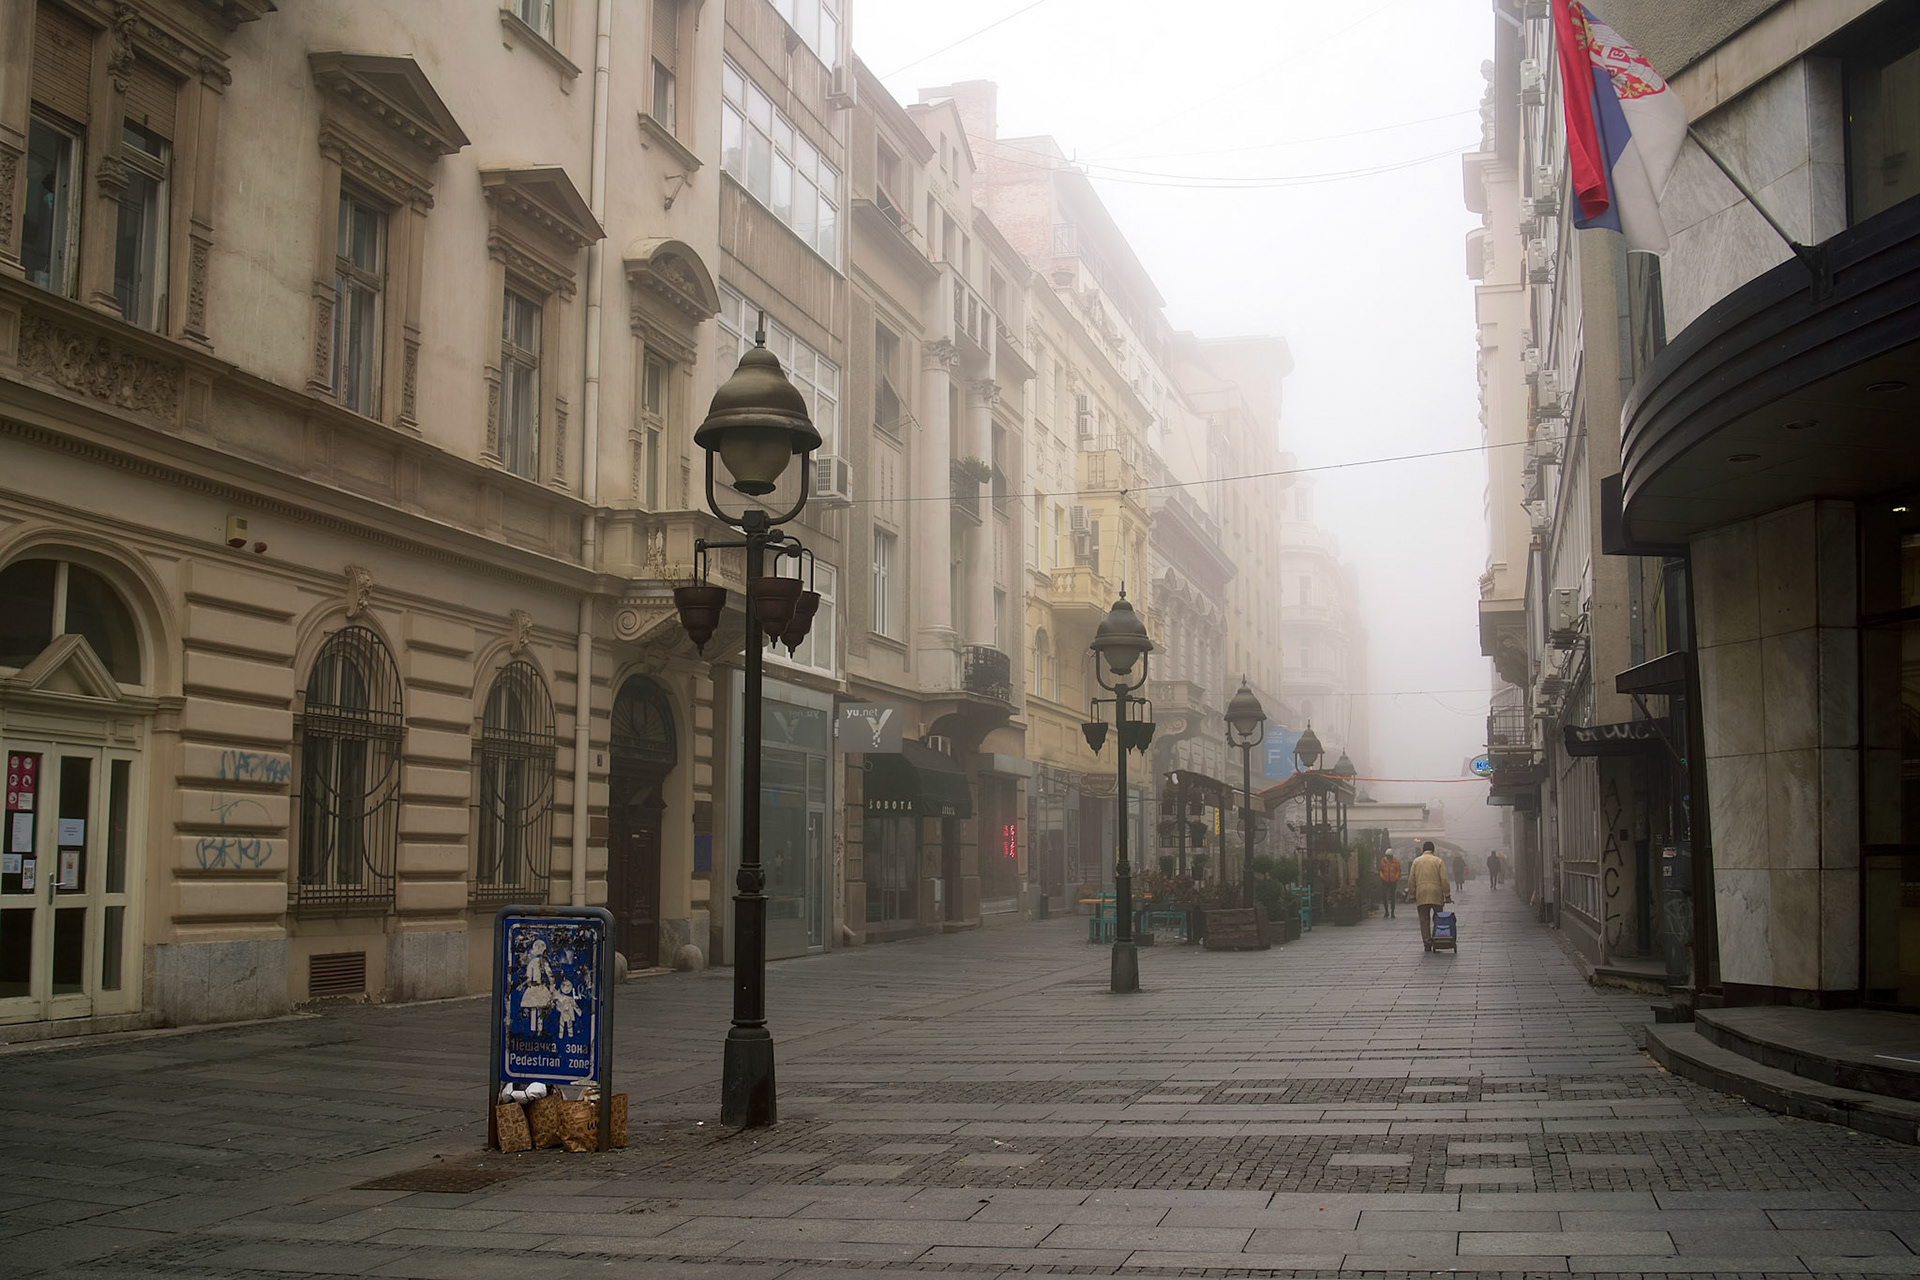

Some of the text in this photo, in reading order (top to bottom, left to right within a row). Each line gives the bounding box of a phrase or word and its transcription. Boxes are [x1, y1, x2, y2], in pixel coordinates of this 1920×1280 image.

[846, 708, 879, 719] yu.net
[509, 1053, 590, 1069] Pedestrian zone
